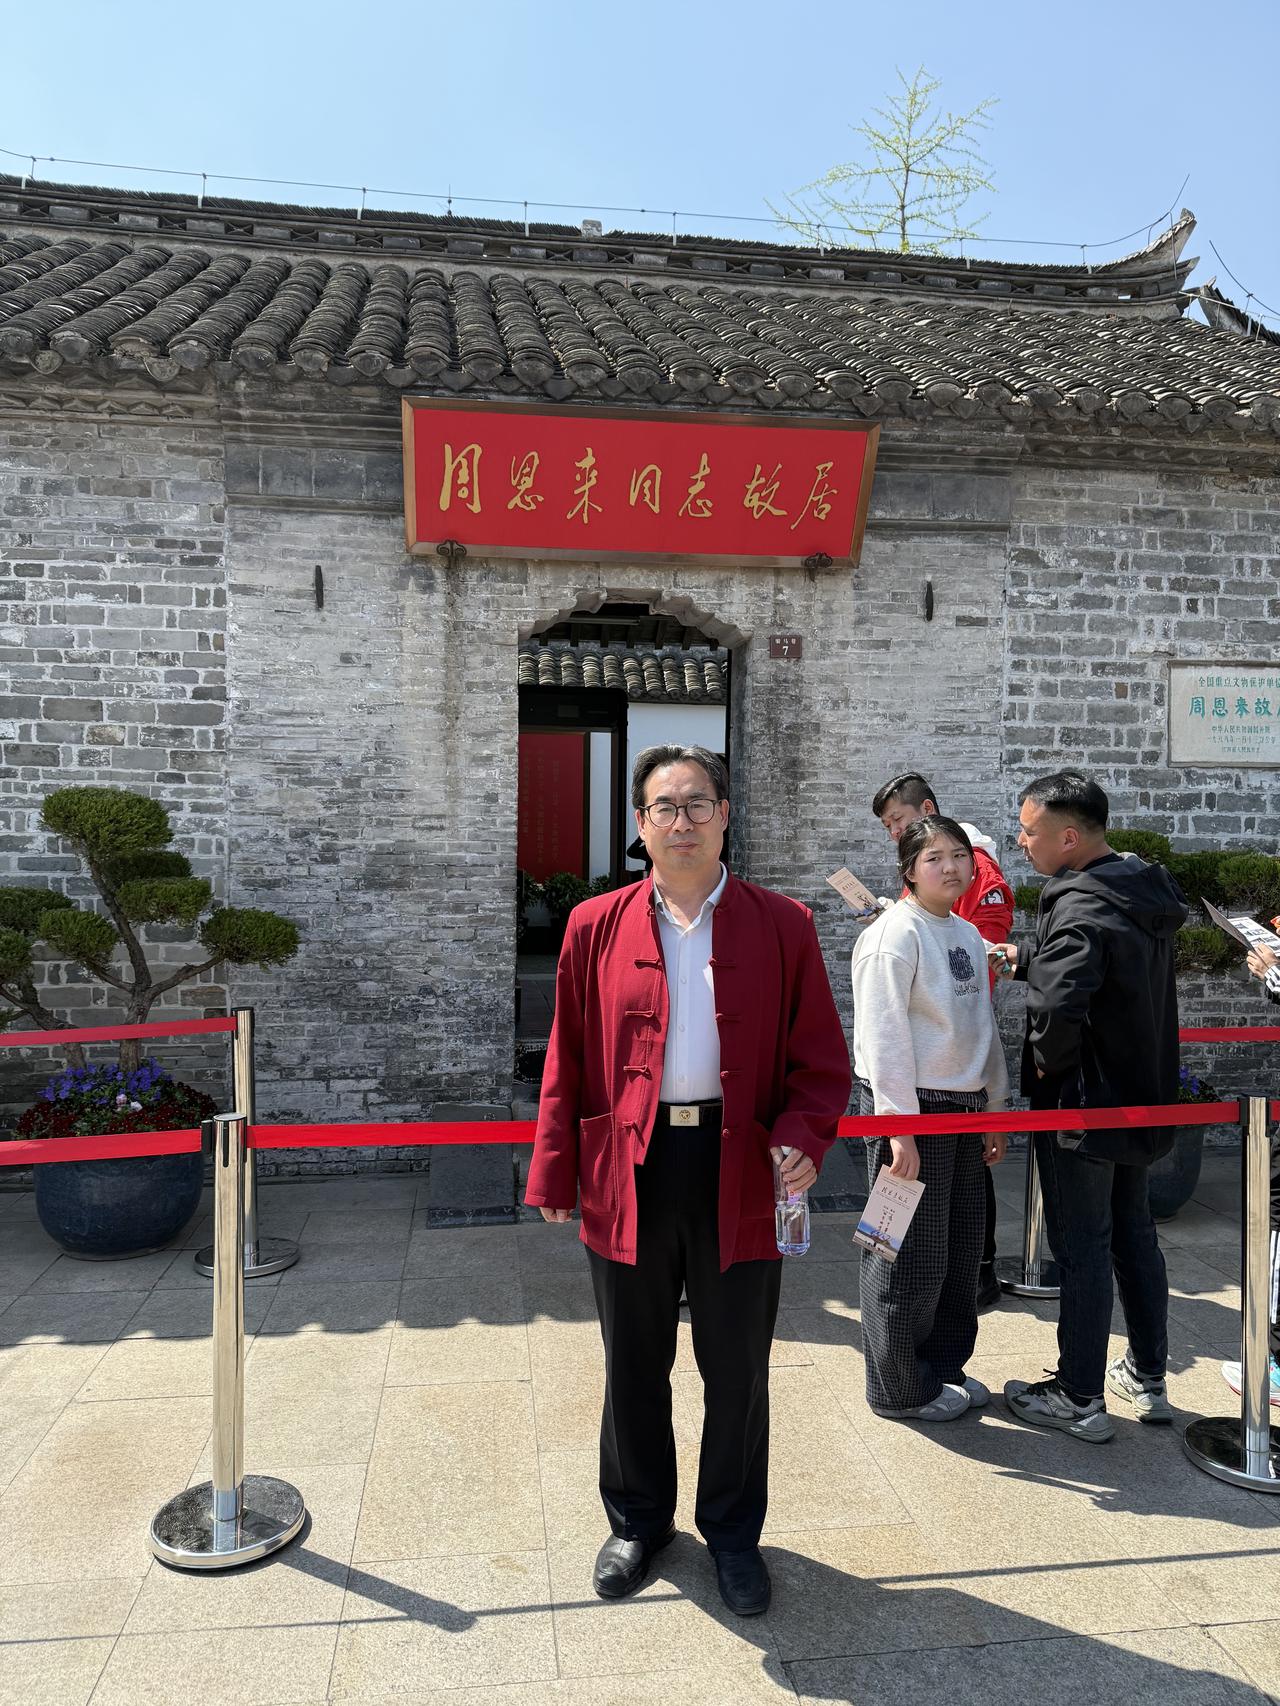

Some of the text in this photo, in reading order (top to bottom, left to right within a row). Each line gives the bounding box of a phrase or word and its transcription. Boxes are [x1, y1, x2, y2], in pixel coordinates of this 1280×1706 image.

[439, 443, 838, 531] 周恩来同志故居
[782, 645, 789, 655] 7
[1189, 696, 1280, 719] 周恩来故
